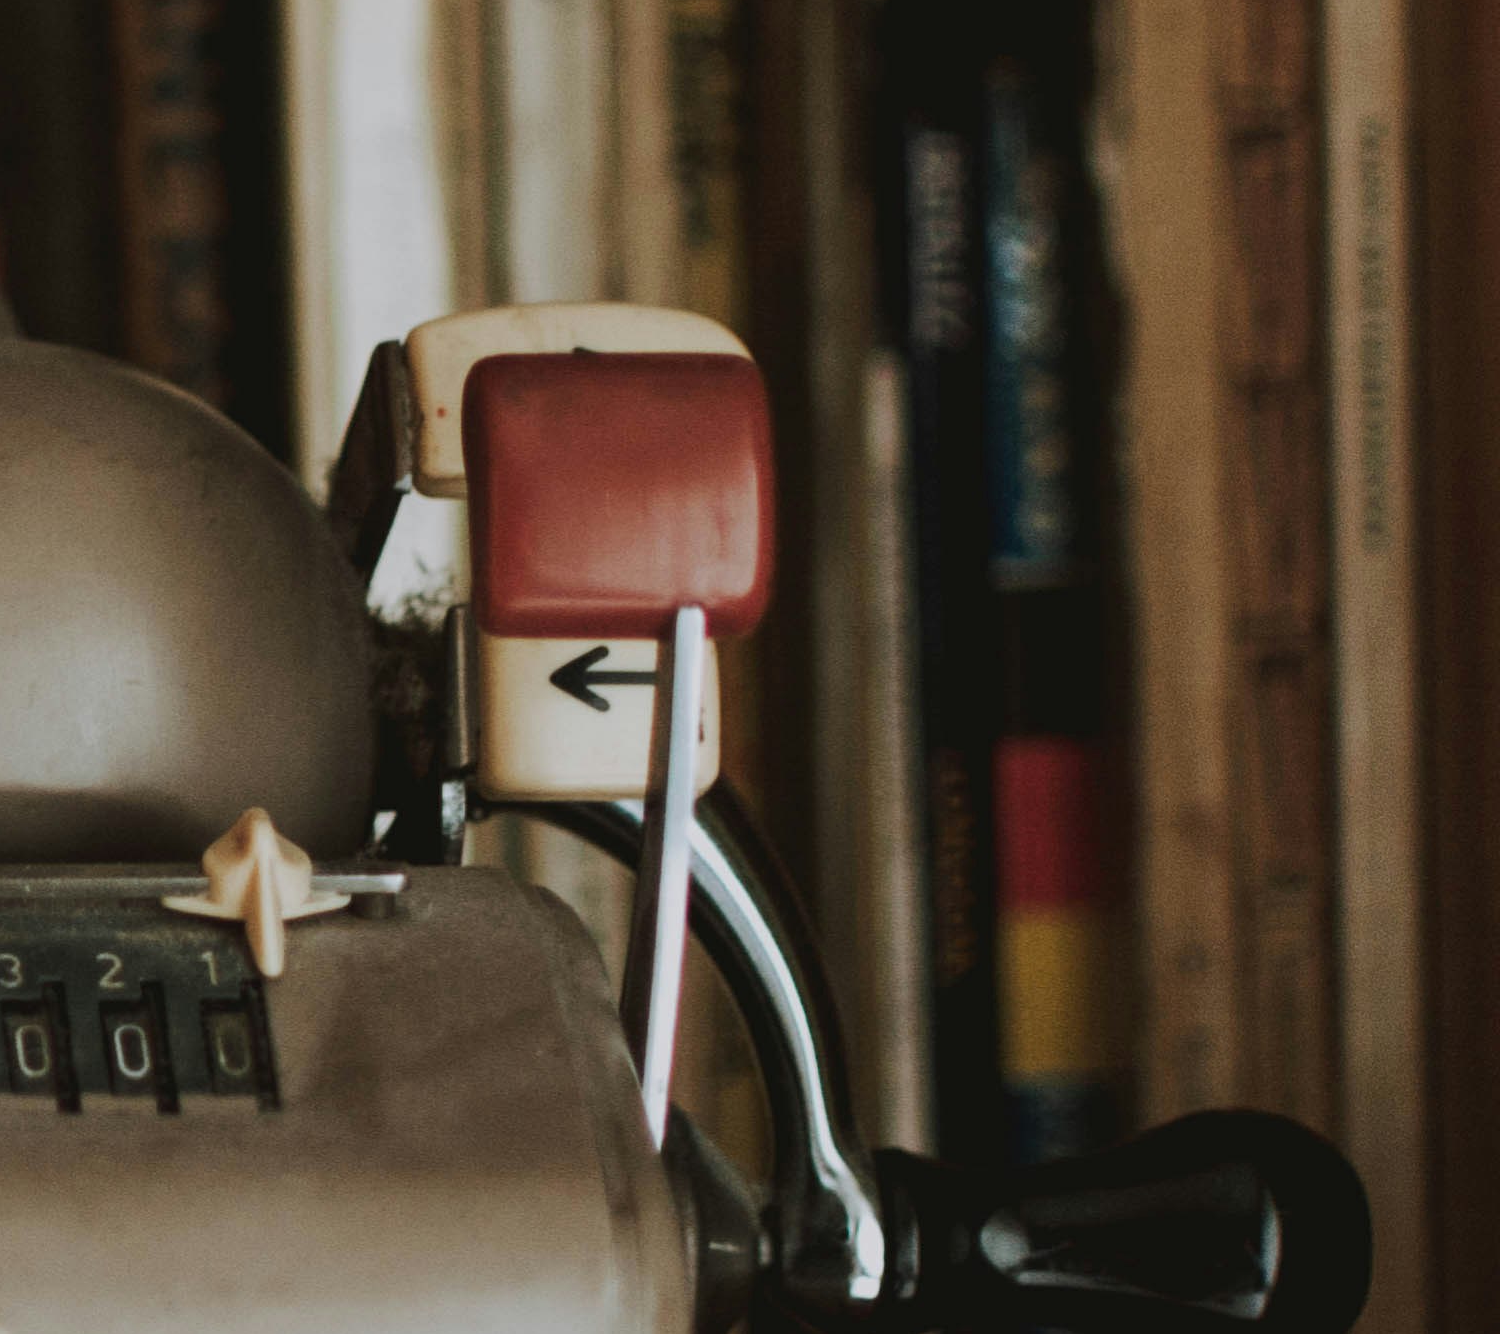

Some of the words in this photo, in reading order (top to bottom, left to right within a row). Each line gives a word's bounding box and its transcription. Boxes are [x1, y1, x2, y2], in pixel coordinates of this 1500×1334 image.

[96, 951, 124, 990] 2
[199, 949, 218, 985] 1
[14, 1025, 49, 1079] 0
[113, 1024, 151, 1080] 0
